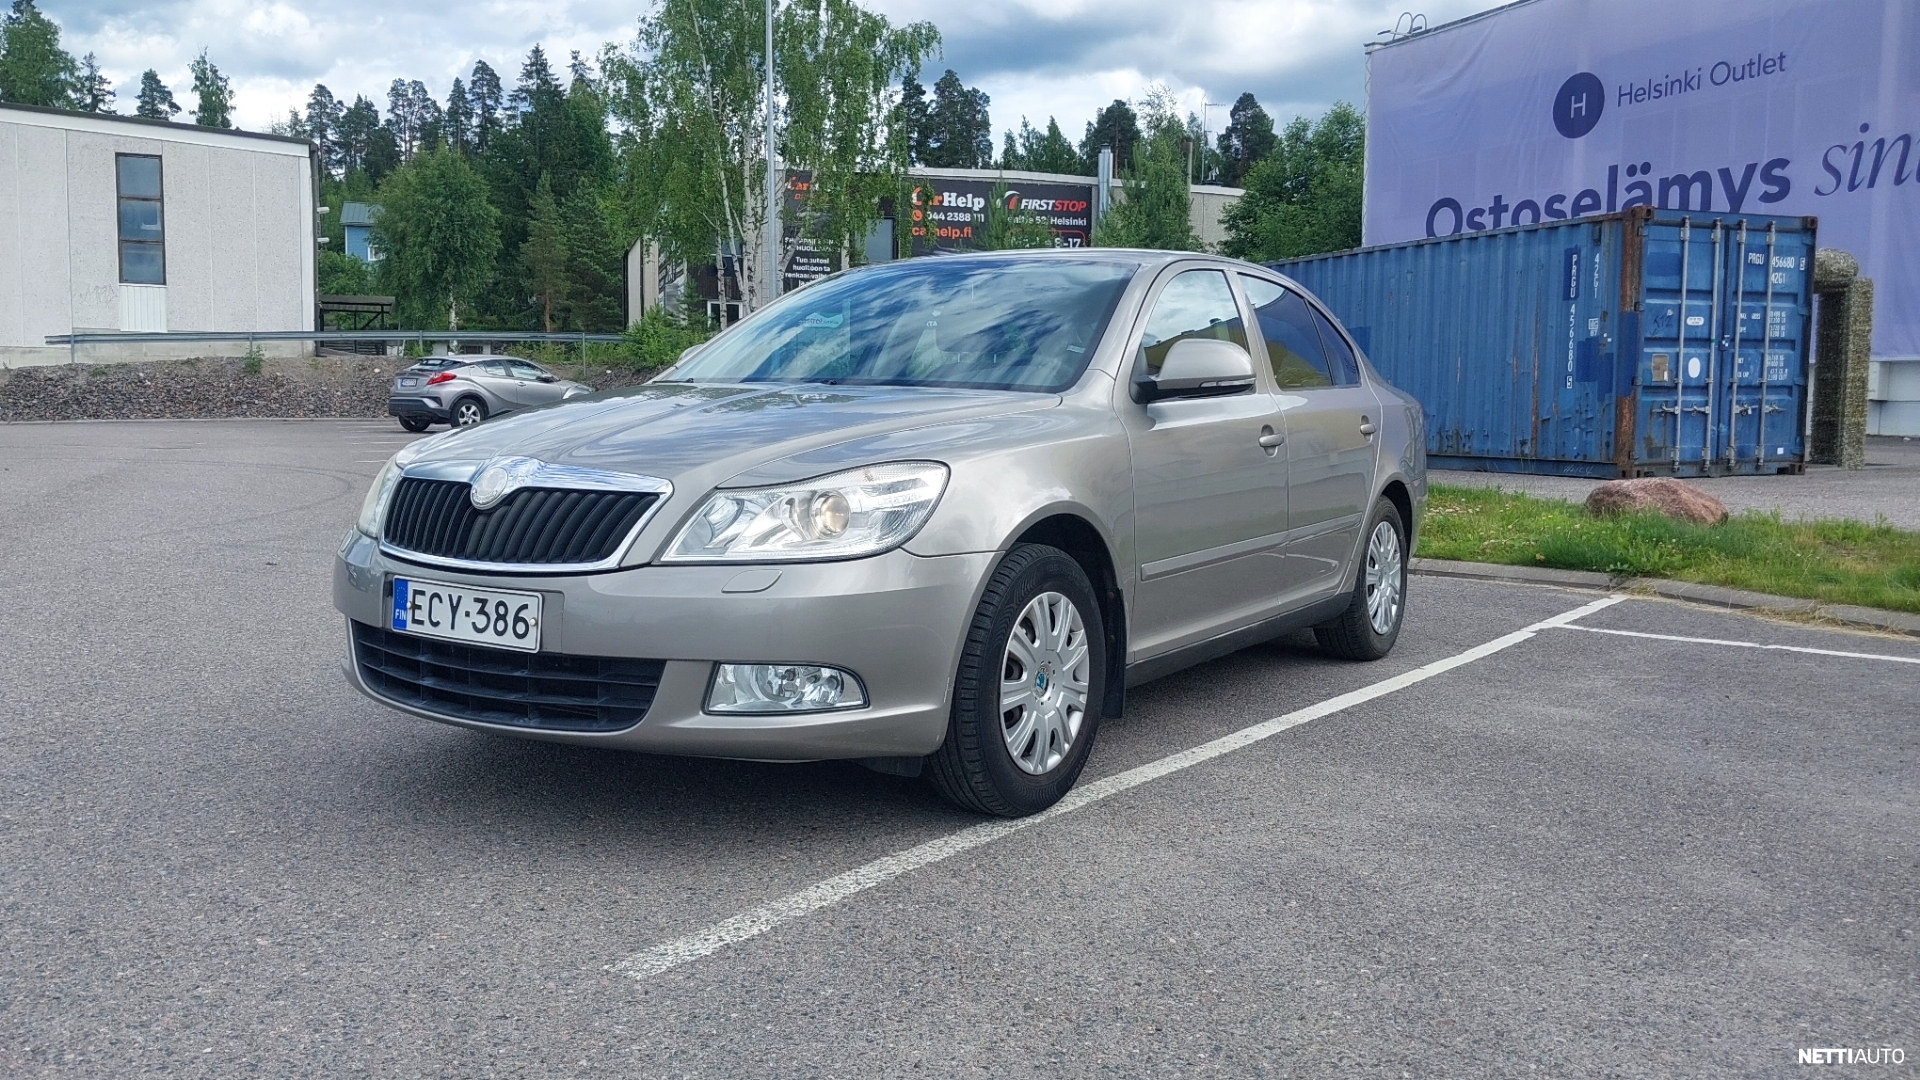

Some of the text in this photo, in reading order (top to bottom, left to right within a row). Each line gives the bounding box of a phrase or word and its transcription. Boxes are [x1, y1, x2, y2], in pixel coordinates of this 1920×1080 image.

[1617, 51, 1788, 108] Helsinki Outlet
[1569, 92, 1587, 119] H
[1813, 121, 1920, 197] sin
[911, 186, 986, 212] CrHelp
[1020, 198, 1088, 212] FIRSTSTOP
[1425, 157, 1792, 239] Ostoselämys
[1050, 216, 1087, 227] Helsinki
[1567, 303, 1576, 372] 456680
[394, 608, 408, 621] FIN
[411, 588, 530, 640] ECY-386
